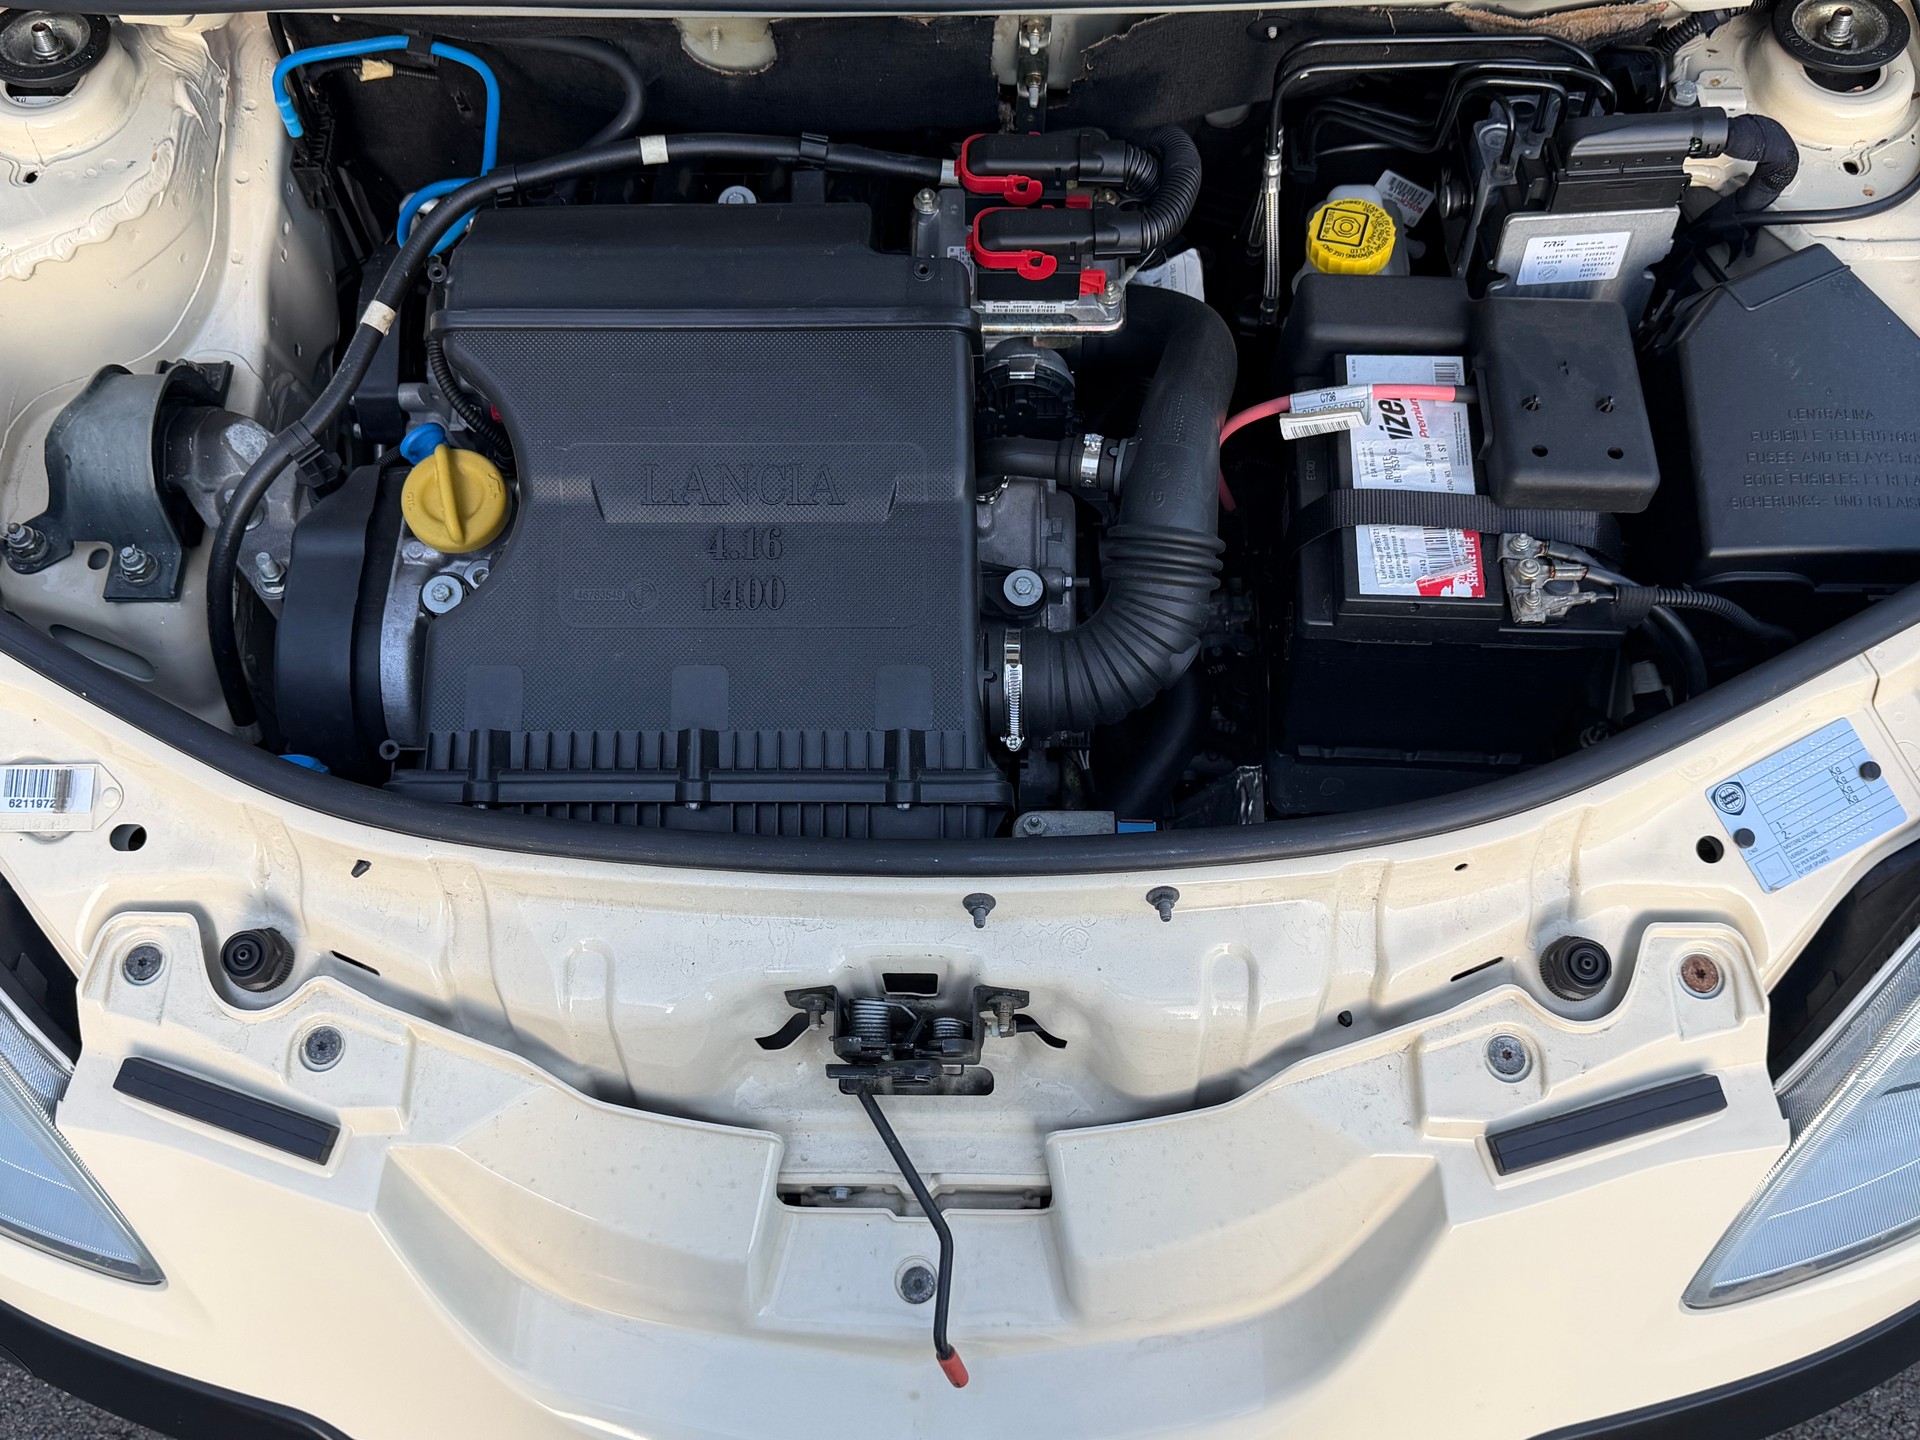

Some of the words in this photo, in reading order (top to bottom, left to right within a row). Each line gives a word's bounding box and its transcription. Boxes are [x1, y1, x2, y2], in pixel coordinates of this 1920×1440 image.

[1543, 240, 1566, 248] TRW
[1787, 407, 1876, 422] CENTRALINA
[1812, 430, 1824, 442] E
[1746, 452, 1795, 464] FUSES
[1802, 451, 1832, 464] AND
[1836, 452, 1894, 464] RELAYS
[640, 462, 846, 506] LANCIA
[1394, 472, 1402, 484] BL
[1742, 473, 1786, 488] BOITE
[1788, 473, 1859, 487] FUSIBLES
[1834, 495, 1863, 510] UND
[708, 526, 784, 561] 4.16
[1466, 537, 1476, 554] LIFE
[576, 590, 623, 600] 46783548
[700, 576, 786, 611] 1400
[1828, 766, 1842, 777] Kg
[1835, 776, 1848, 787] Kg
[1842, 786, 1854, 796] Kg
[8, 798, 62, 809] 6211972
[1848, 795, 1860, 806] Kg
[1788, 848, 1809, 860] VERSION
